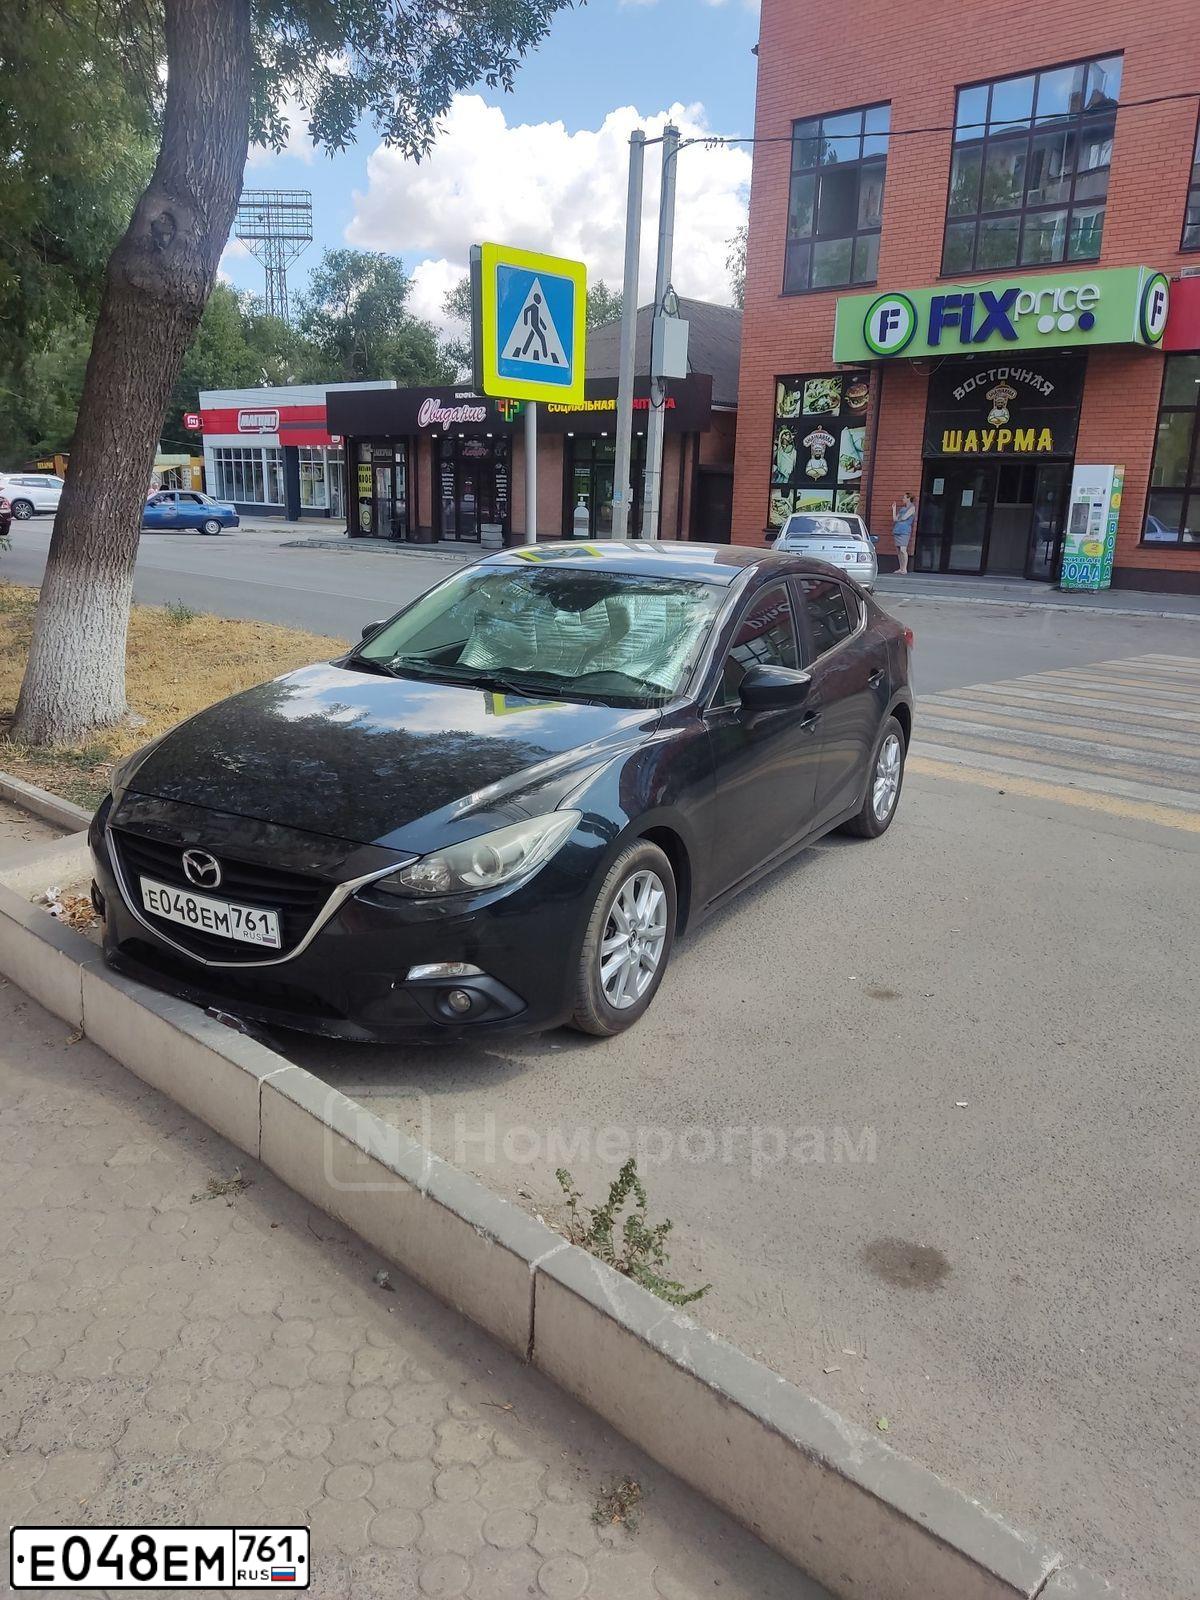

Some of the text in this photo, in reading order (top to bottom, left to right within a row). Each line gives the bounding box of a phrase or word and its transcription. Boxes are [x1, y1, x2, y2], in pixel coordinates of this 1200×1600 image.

[1014, 283, 1101, 322] price
[1150, 290, 1165, 327] F
[879, 309, 901, 343] F
[953, 367, 1055, 401] ВОСТОЧНАЯ
[417, 397, 487, 431] Свидание
[548, 399, 616, 414] СОЦИАЛЬНАЯ
[942, 428, 1054, 452] ШАУРМА
[148, 889, 269, 934] Е048ЕМ 761
[243, 930, 262, 941] RUS
